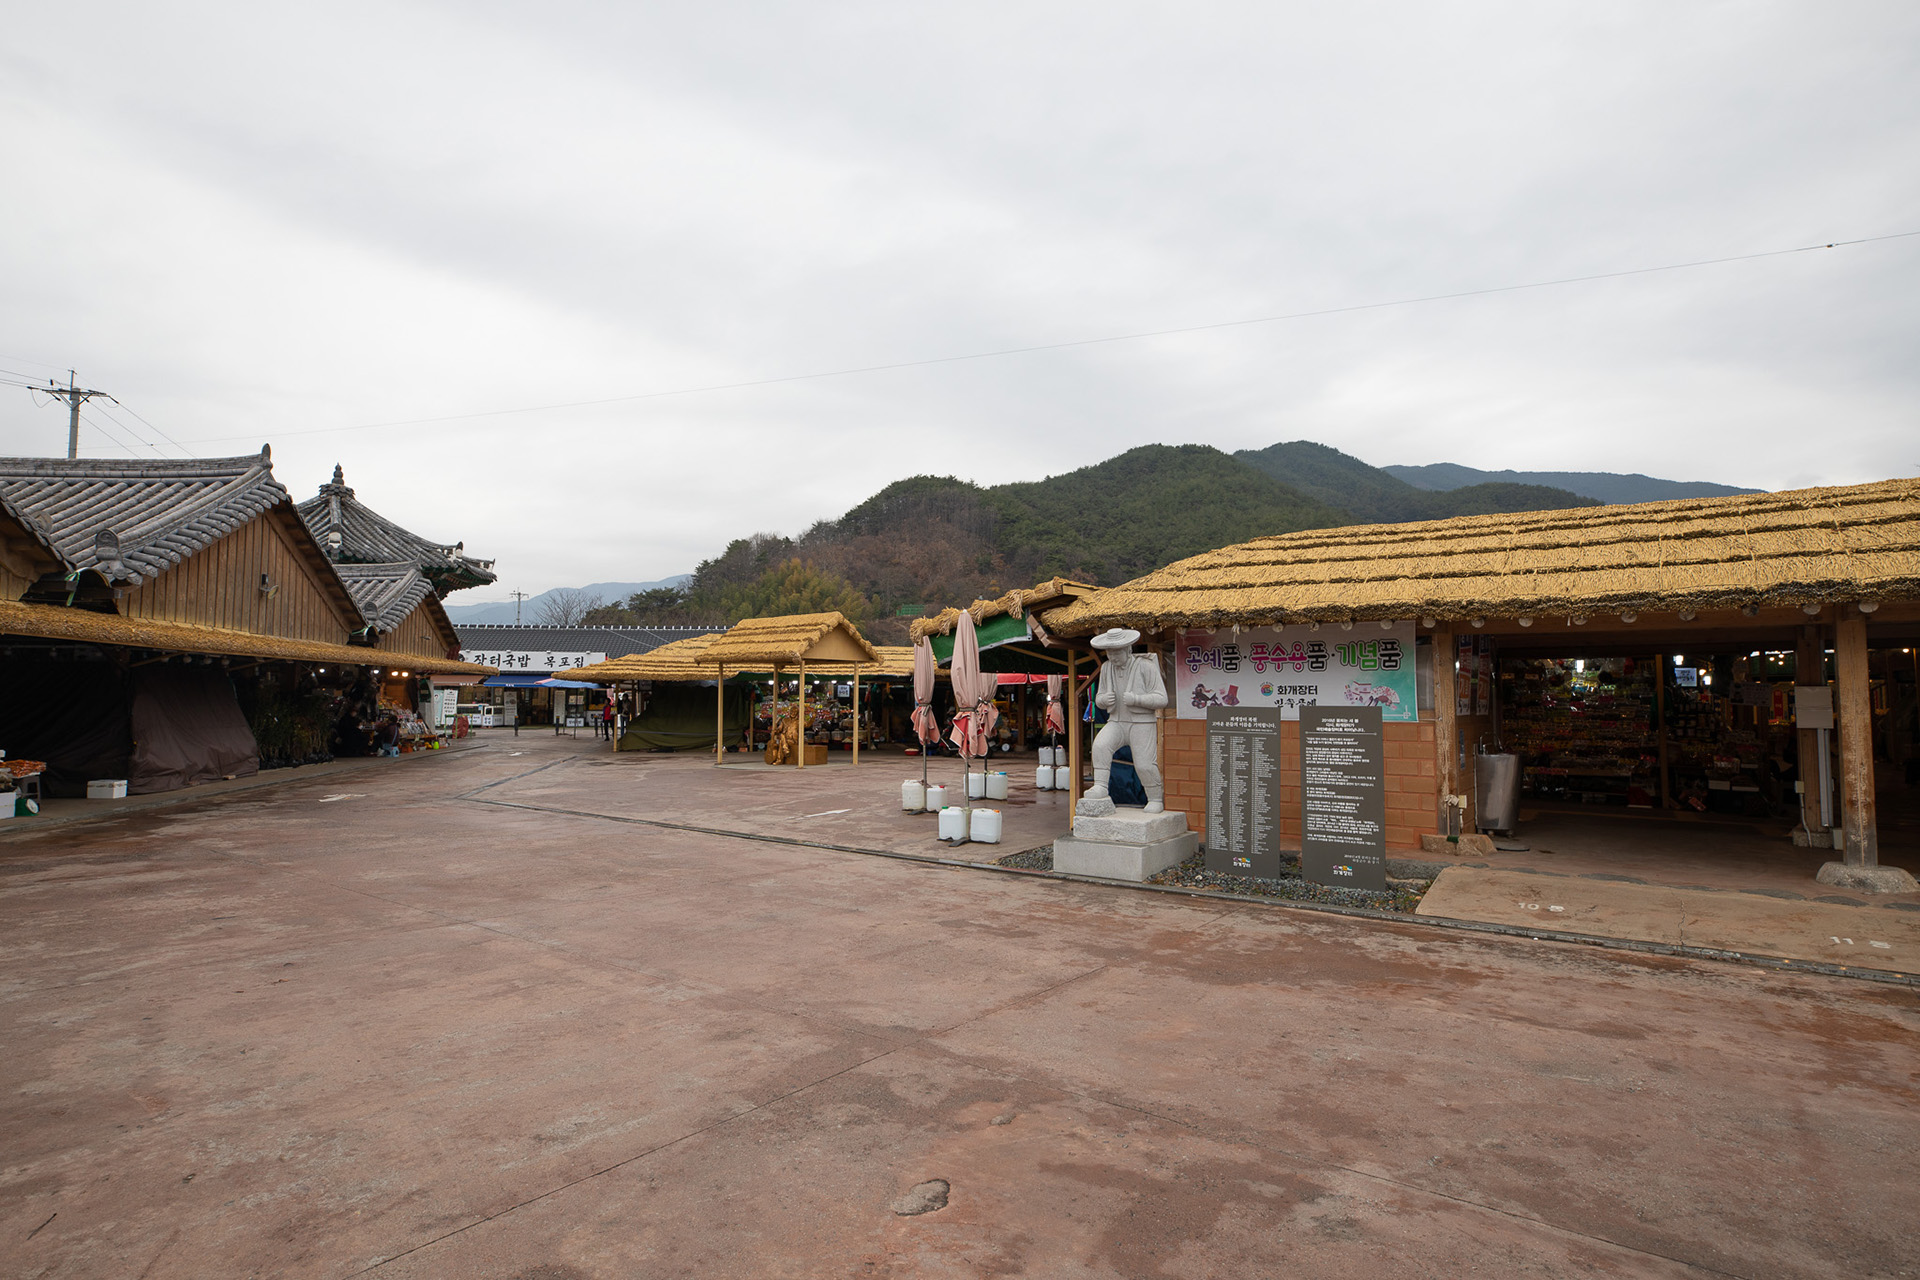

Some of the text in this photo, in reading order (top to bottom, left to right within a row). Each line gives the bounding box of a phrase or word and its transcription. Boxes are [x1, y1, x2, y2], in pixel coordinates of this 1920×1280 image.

[473, 653, 585, 668] 장터국밥 목포집
[1277, 685, 1318, 696] 화개장터
[1518, 902, 1540, 910] 10
